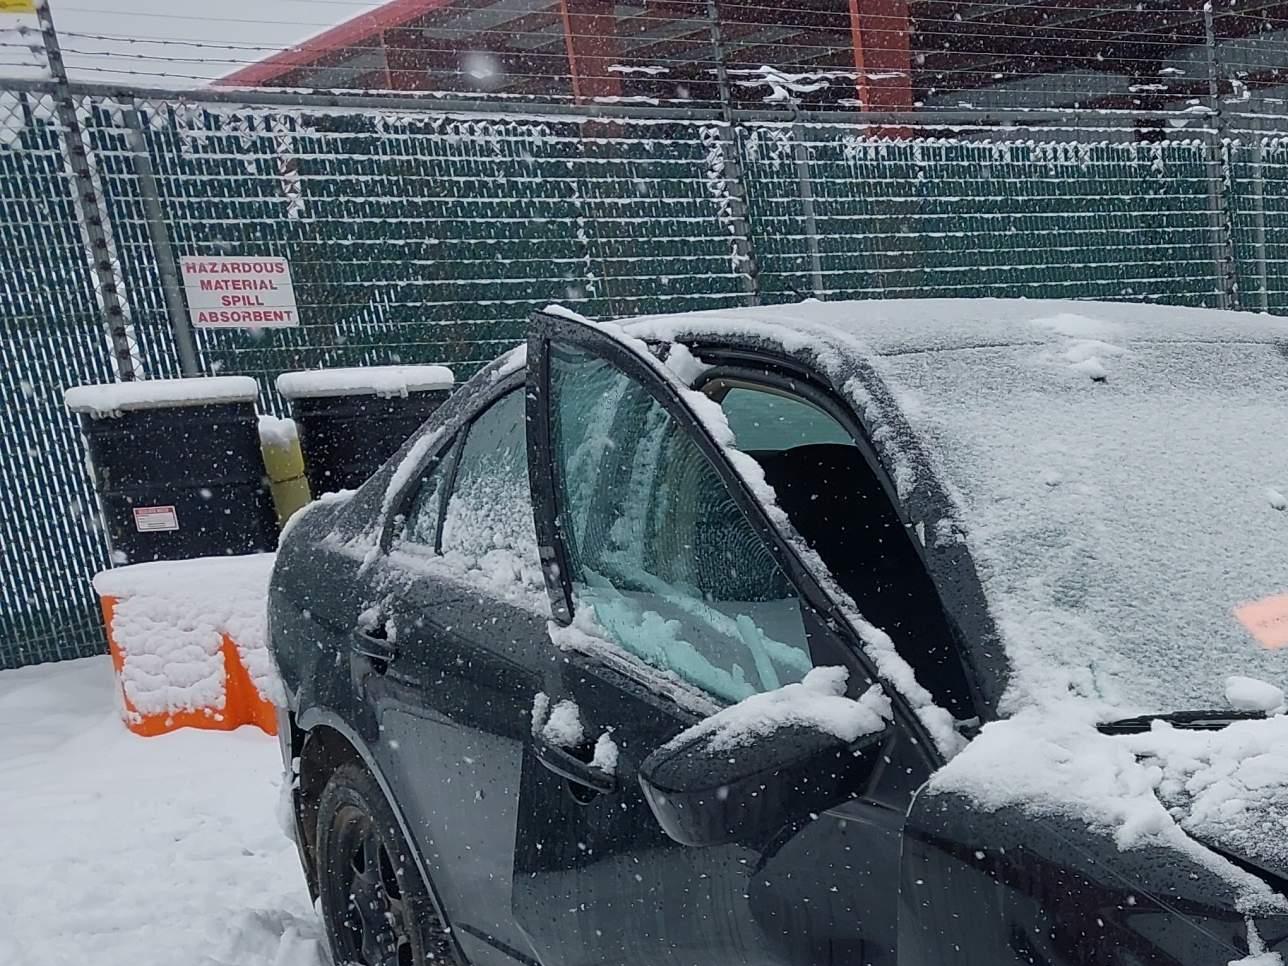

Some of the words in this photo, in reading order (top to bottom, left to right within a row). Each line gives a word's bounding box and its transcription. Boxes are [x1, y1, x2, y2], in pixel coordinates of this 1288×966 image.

[185, 261, 285, 274] HAZARDOUS
[199, 279, 278, 291] MATERIAL
[220, 295, 265, 306] SPILL
[197, 310, 293, 323] ABSORBENT
